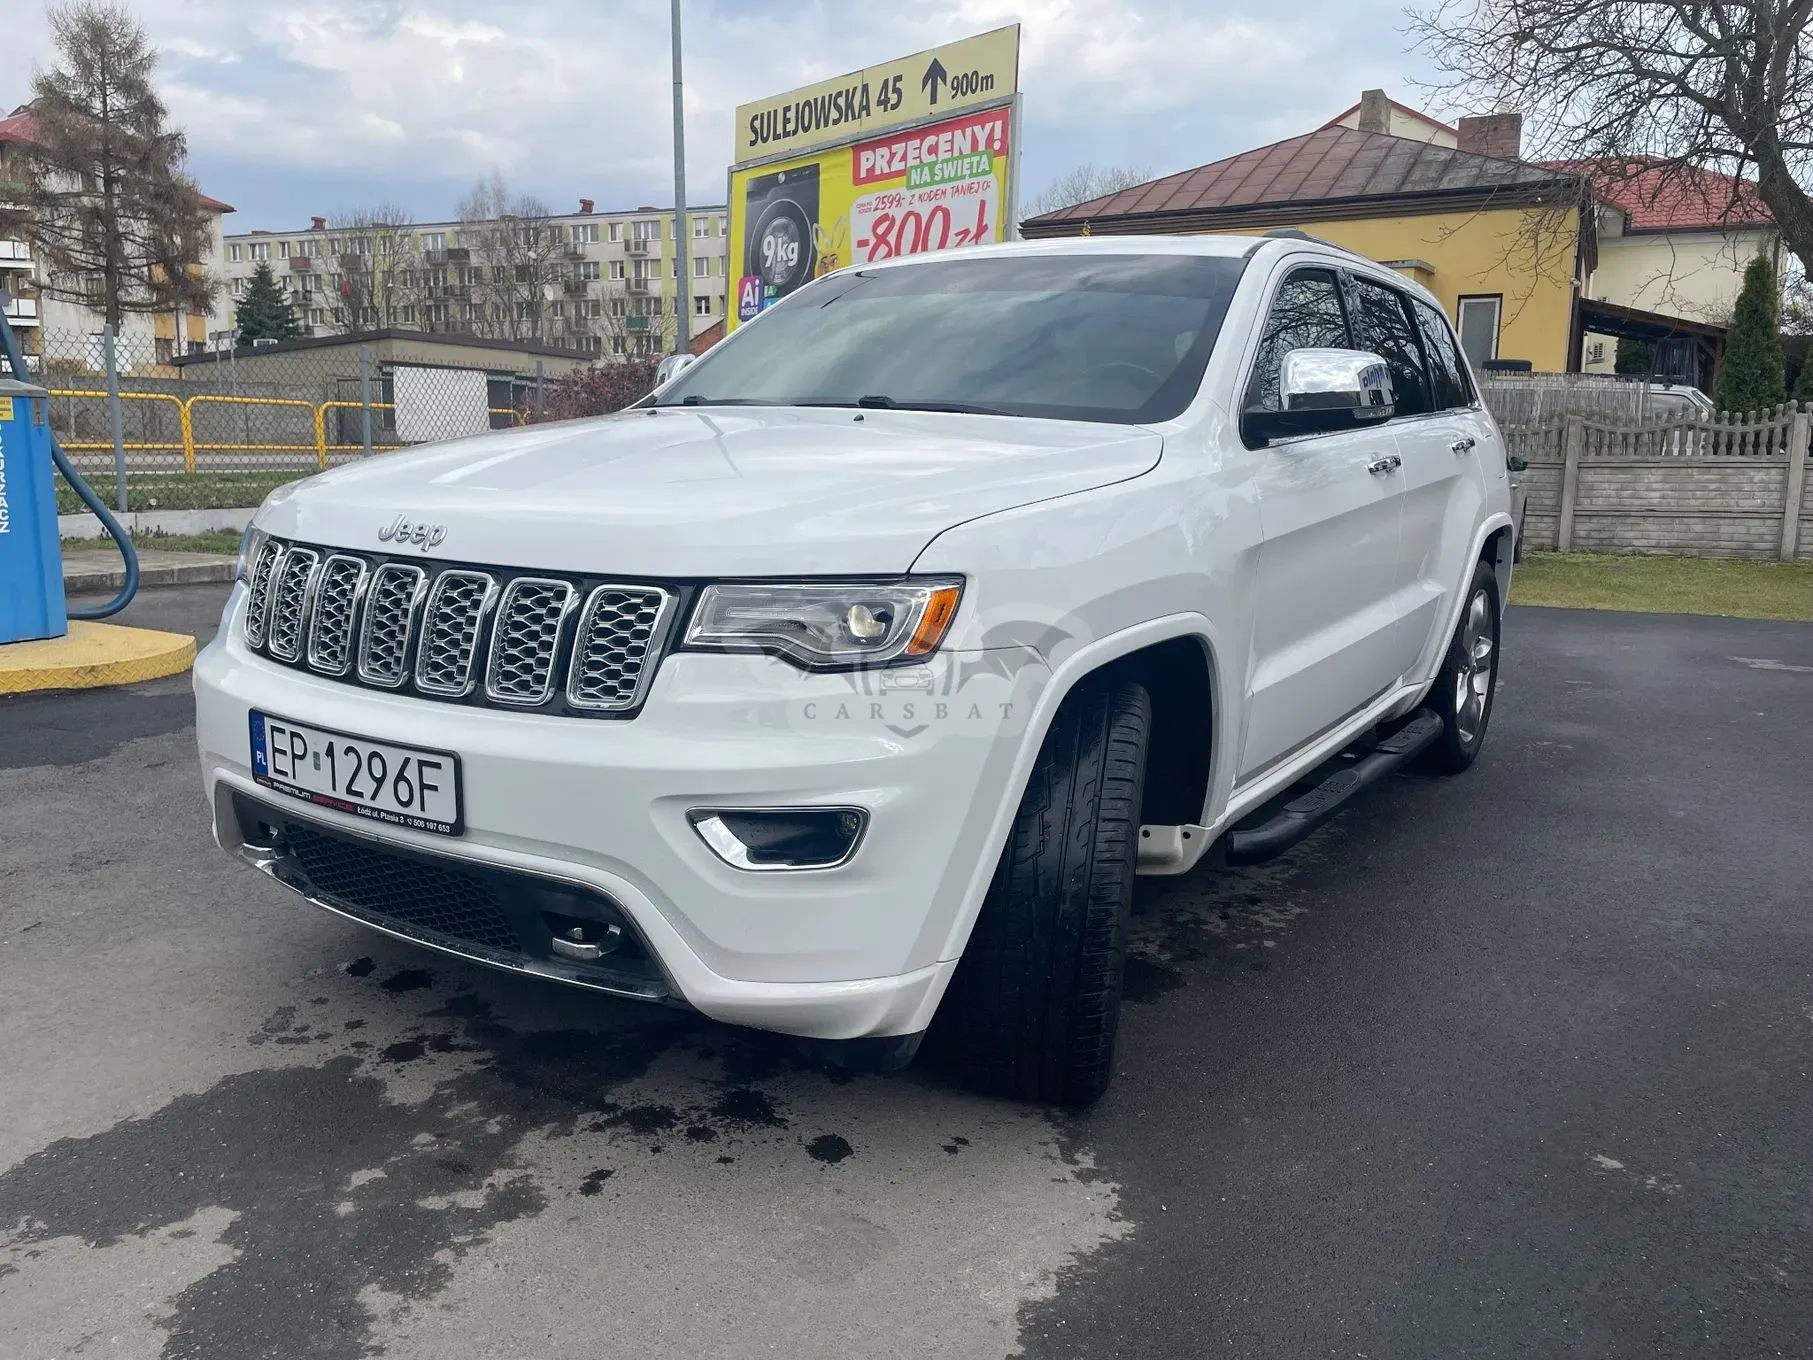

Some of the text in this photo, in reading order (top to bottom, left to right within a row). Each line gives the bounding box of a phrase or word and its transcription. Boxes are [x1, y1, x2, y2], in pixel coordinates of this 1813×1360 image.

[749, 70, 994, 147] SULEJOWSKA 45 900m
[860, 120, 1002, 178] PRZECENY!
[911, 154, 990, 186] NA ŚWIĘTA
[919, 189, 946, 203] KODEM
[950, 182, 981, 199] TANIEJ
[857, 205, 951, 262] -800
[741, 278, 760, 307] Ai
[378, 514, 447, 552] Jeep
[256, 750, 267, 766] PL
[270, 725, 443, 812] EP 1296F
[426, 821, 437, 830] 197
